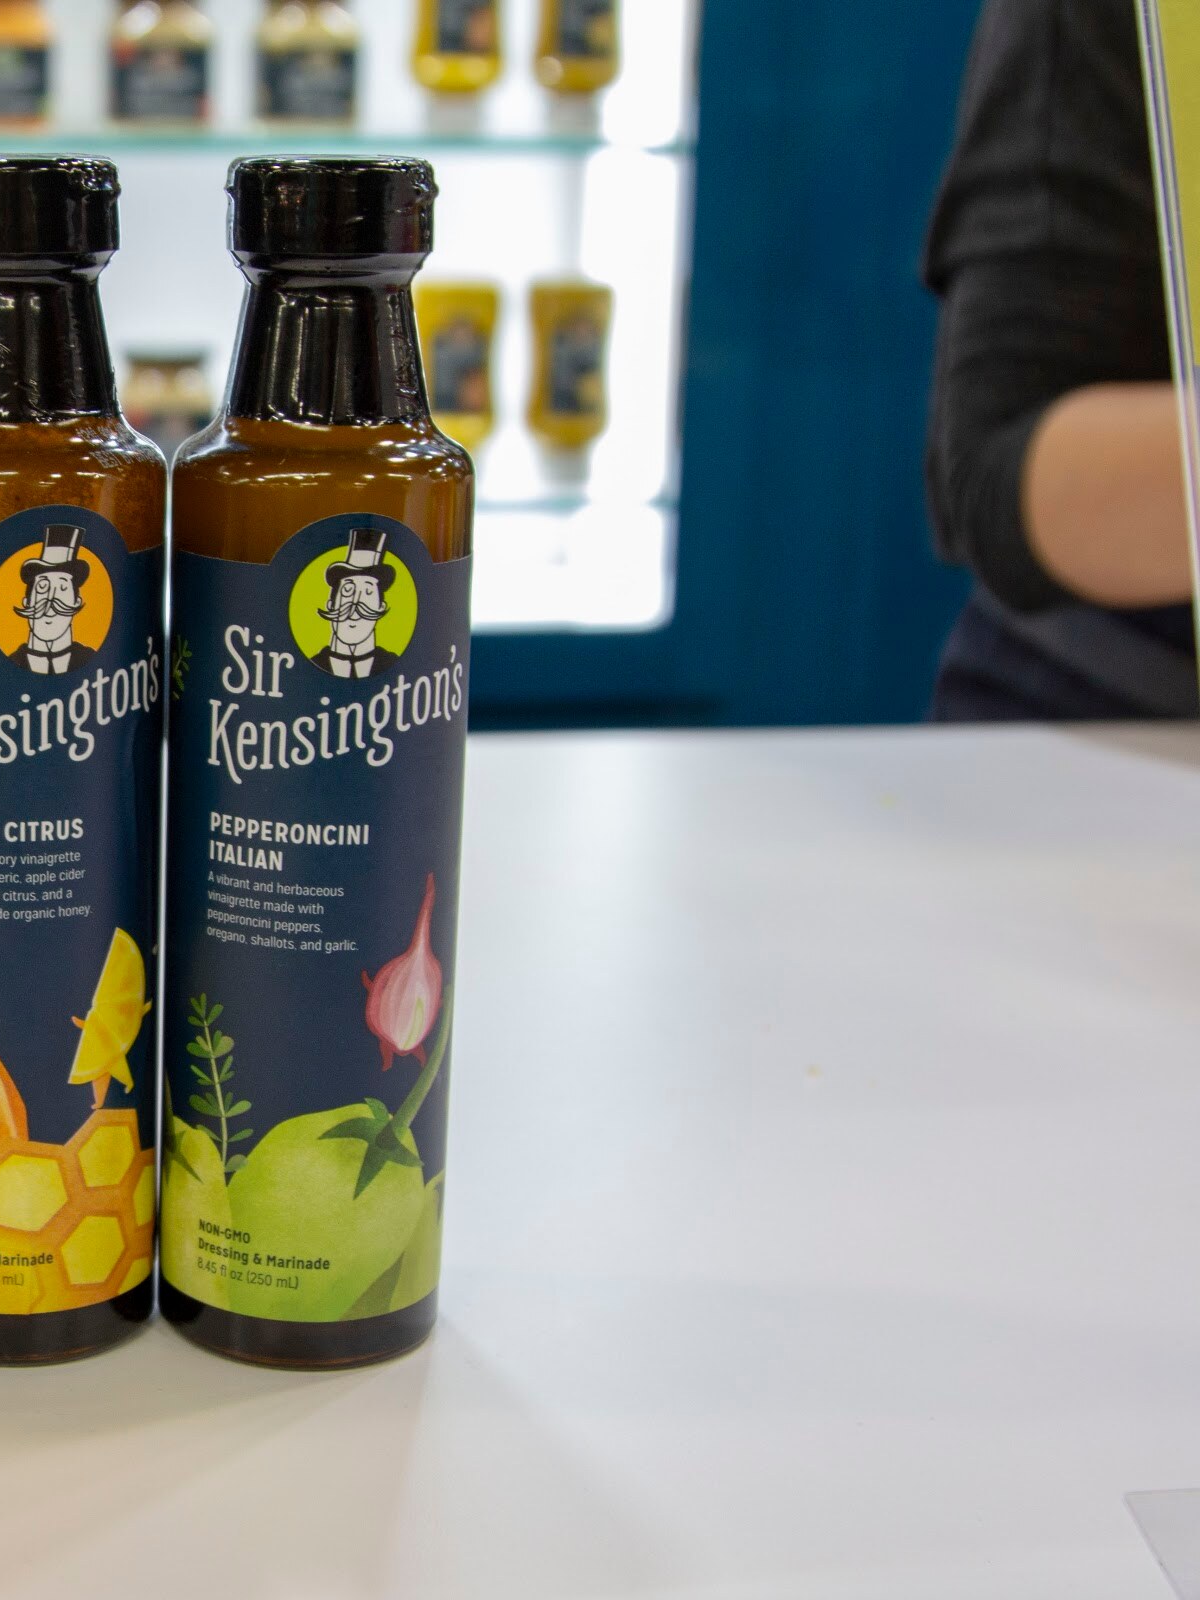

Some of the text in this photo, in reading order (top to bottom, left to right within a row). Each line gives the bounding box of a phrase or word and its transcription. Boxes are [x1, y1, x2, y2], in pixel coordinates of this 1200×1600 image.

[222, 624, 295, 698] Sir
[207, 645, 463, 785] Kensington's
[4, 817, 84, 843] CITRUS
[210, 811, 369, 845] PEPPERONCINI
[20, 851, 81, 867] vinaigrette
[209, 840, 284, 871] ITALIAN
[25, 871, 57, 885] apple
[59, 867, 86, 881] cider
[208, 870, 345, 897] A vibrant and herbaceous
[41, 888, 63, 901] and
[65, 888, 73, 899] a
[208, 890, 325, 915] vinaigrette made with
[13, 907, 56, 923] organic
[58, 904, 93, 918] honey.
[207, 908, 272, 928] pepperoncini
[300, 940, 322, 951] and
[325, 940, 359, 954] garlic.
[199, 1219, 251, 1244] NON-GMO
[198, 1237, 331, 1270] Dressing & Marinade
[2, 1273, 25, 1287] mL)
[197, 1257, 299, 1290] 8.45 fl oz (250 mL)
